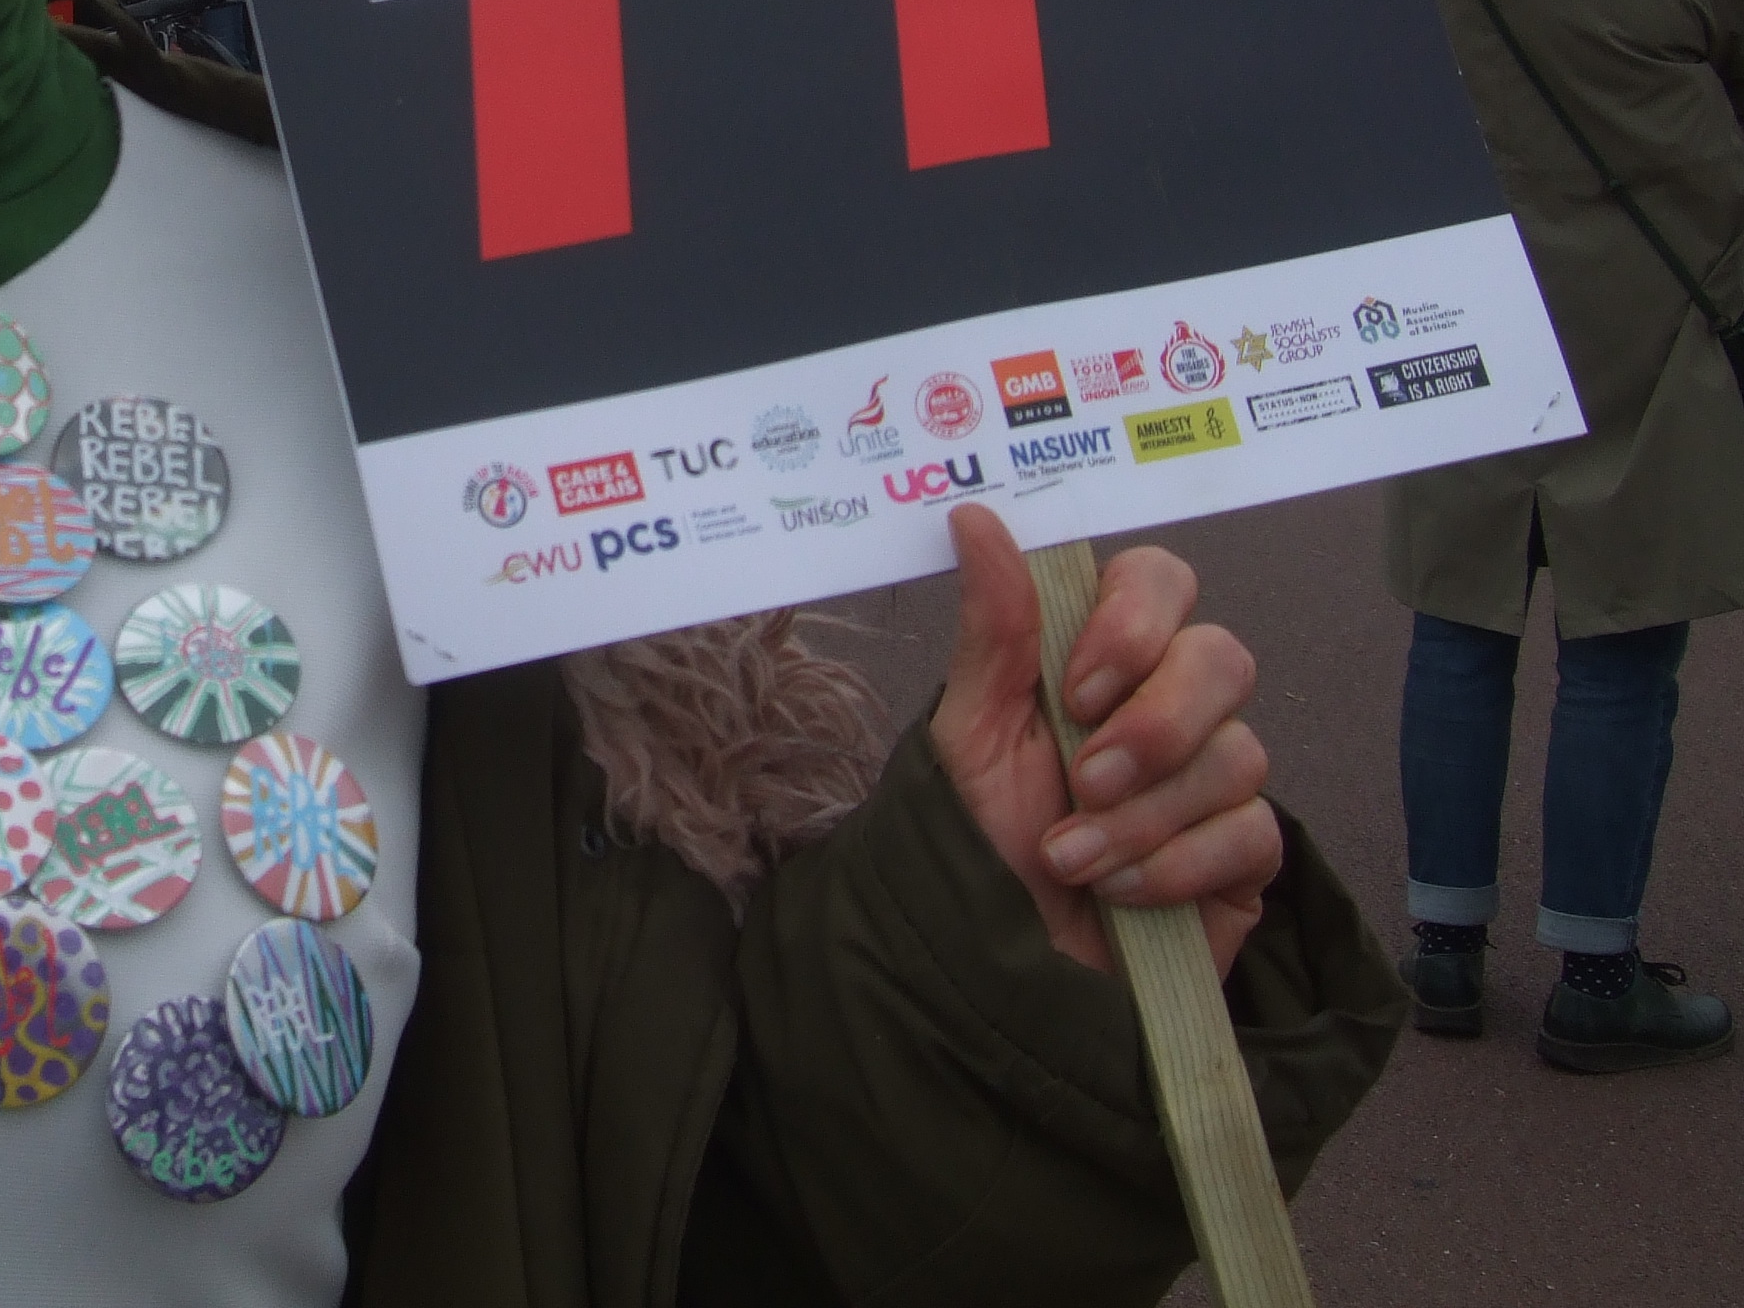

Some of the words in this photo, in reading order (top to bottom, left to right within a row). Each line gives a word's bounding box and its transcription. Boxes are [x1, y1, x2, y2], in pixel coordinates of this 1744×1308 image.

[1402, 301, 1439, 316] Muslim
[1406, 307, 1465, 327] Association
[1270, 316, 1315, 338] JEWISH
[1273, 325, 1341, 351] SOCIALISTS
[1409, 326, 1420, 337] of
[1422, 319, 1458, 335] Britain
[1278, 344, 1323, 365] GROUP
[1401, 347, 1479, 380] CITIZENSHIP
[1004, 371, 1058, 398] GMB
[1080, 389, 1120, 404] UNION
[1407, 384, 1421, 401] IS
[1423, 381, 1435, 397] A
[1436, 371, 1474, 395] RIGHT
[78, 403, 216, 444] REBEL
[1013, 402, 1065, 423] UNION
[1136, 415, 1192, 441] AMNESTY
[1009, 426, 1112, 469] NASUWT
[1139, 433, 1196, 452] INTERNATIONAL
[79, 437, 224, 493] REBEL
[650, 438, 740, 482] TUC
[1017, 468, 1037, 481] The
[1086, 453, 1117, 468] Union
[560, 478, 641, 507] CALAIS
[781, 495, 870, 532] UNISON
[590, 517, 681, 572] pcs
[502, 542, 583, 584] CWU
